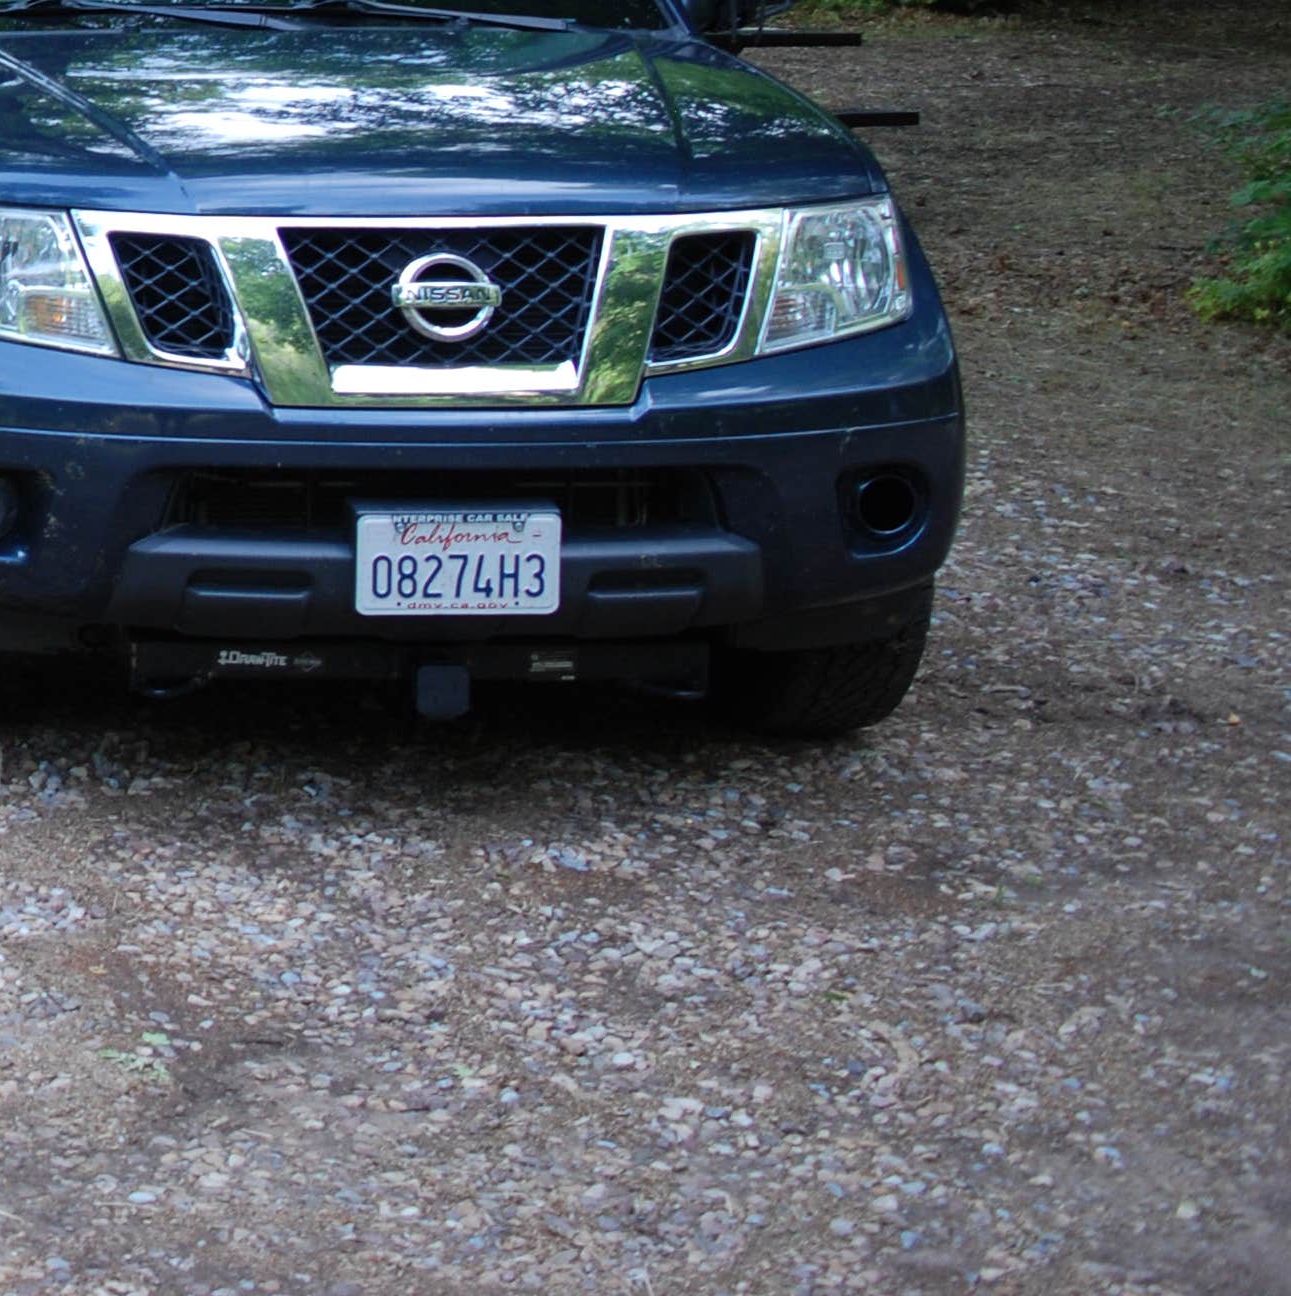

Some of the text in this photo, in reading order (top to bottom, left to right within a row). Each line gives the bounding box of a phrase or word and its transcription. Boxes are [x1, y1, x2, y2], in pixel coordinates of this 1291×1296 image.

[404, 287, 492, 304] NISSAN
[392, 513, 463, 523] NTERPRISE
[466, 513, 493, 523] CAR
[401, 522, 522, 551] California
[372, 554, 546, 599] 08274H3
[406, 601, 508, 610] dmv.ca.gov
